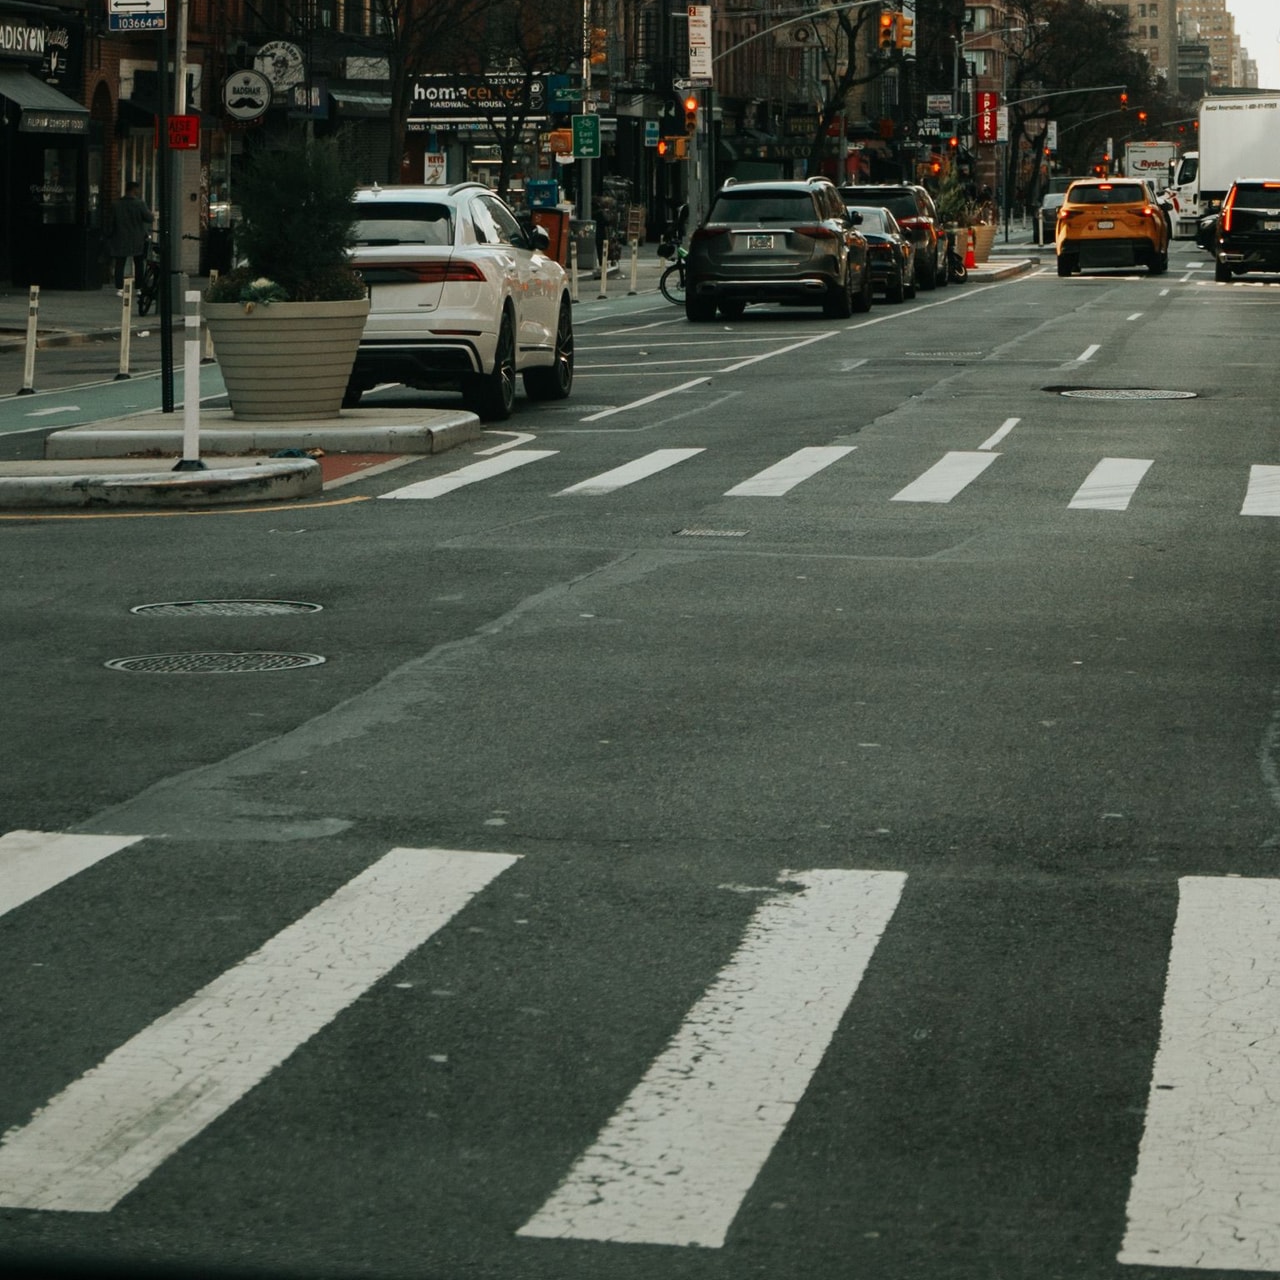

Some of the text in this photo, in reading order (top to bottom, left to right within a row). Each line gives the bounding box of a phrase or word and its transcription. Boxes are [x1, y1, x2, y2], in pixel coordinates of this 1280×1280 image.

[983, 101, 991, 131] PARK
[168, 120, 191, 132] AISE
[918, 128, 940, 136] ATM
[169, 134, 189, 143] LOW
[1140, 159, 1165, 168] Ryder
